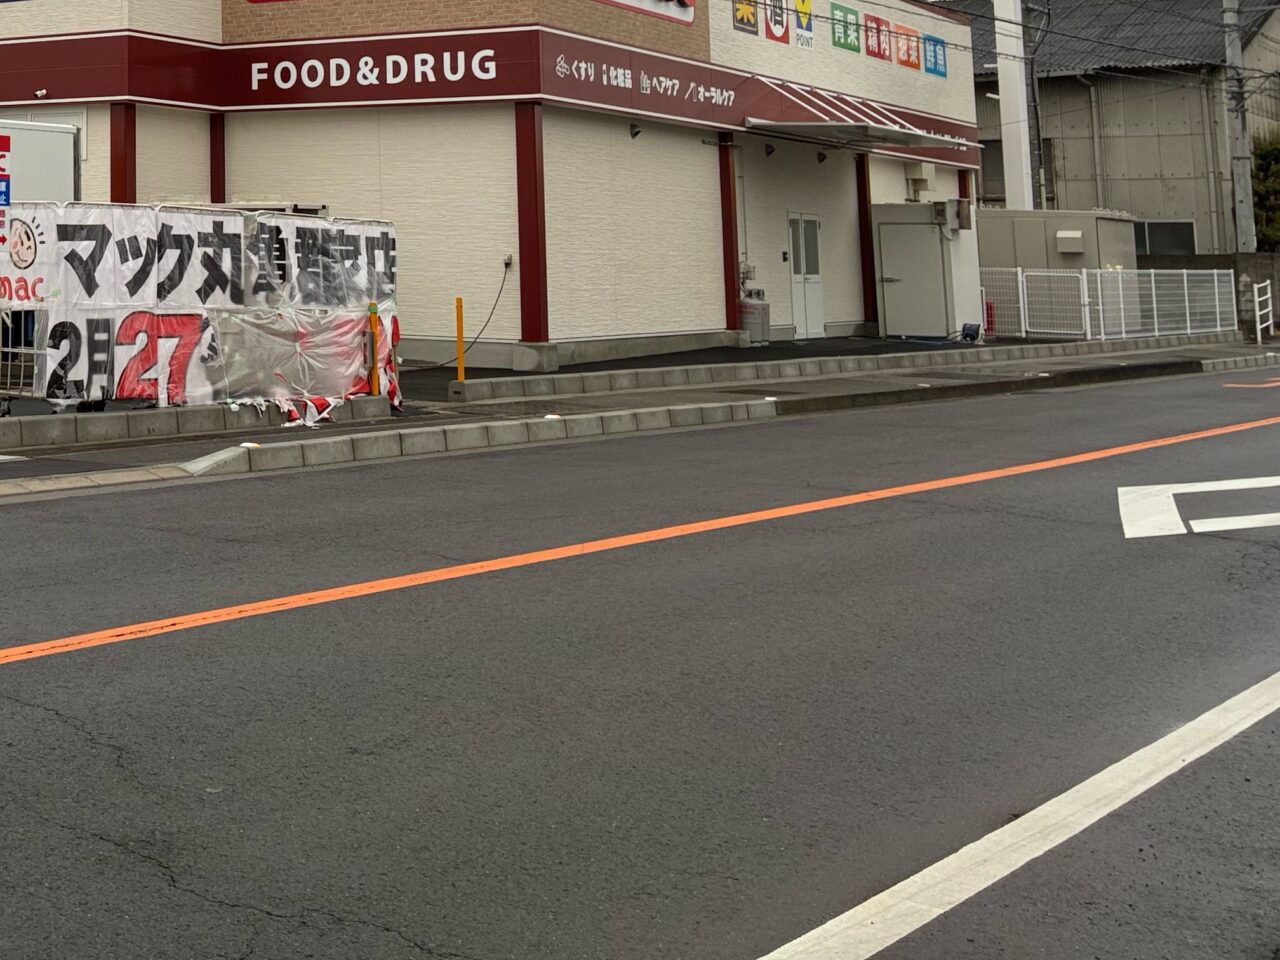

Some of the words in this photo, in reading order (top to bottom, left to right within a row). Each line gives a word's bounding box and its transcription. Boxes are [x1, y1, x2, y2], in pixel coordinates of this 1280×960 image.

[833, 9, 858, 46] 青果
[866, 20, 890, 56] 精肉
[796, 33, 813, 49] POINT
[251, 49, 498, 91] FOOD&DRUG
[571, 59, 595, 82] くすり
[609, 66, 633, 88] 化粧品
[652, 76, 680, 96] ヘアケア
[697, 84, 735, 107] オーラルケア
